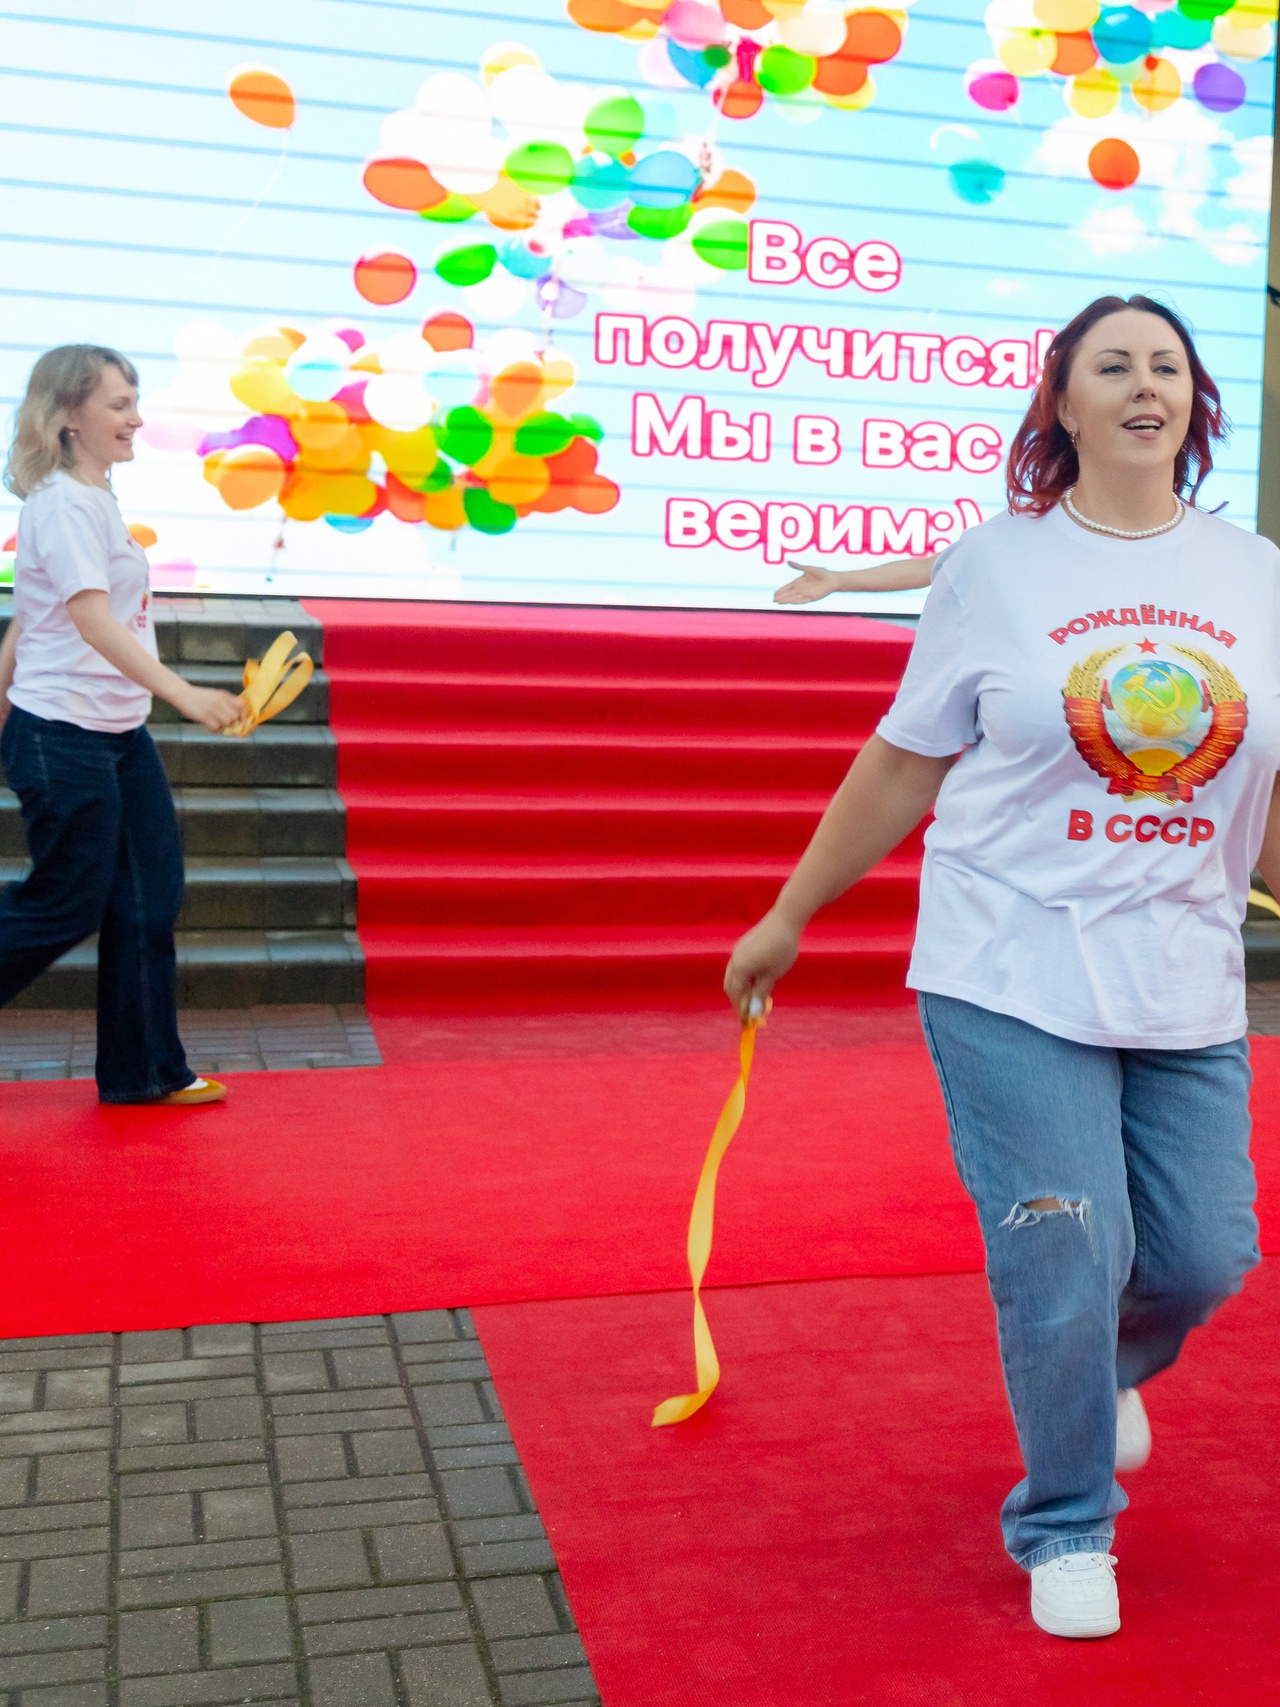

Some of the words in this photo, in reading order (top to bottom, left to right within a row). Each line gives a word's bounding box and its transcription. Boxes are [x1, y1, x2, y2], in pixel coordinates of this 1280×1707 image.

[748, 219, 902, 292] Все
[595, 313, 1055, 388] получится!
[631, 393, 770, 462] Мы
[793, 414, 841, 465] в
[862, 418, 1003, 474] вас
[1048, 604, 1237, 649] РОЖДЁННАЯ
[1067, 809, 1093, 842] В
[1105, 813, 1215, 848] СССР
